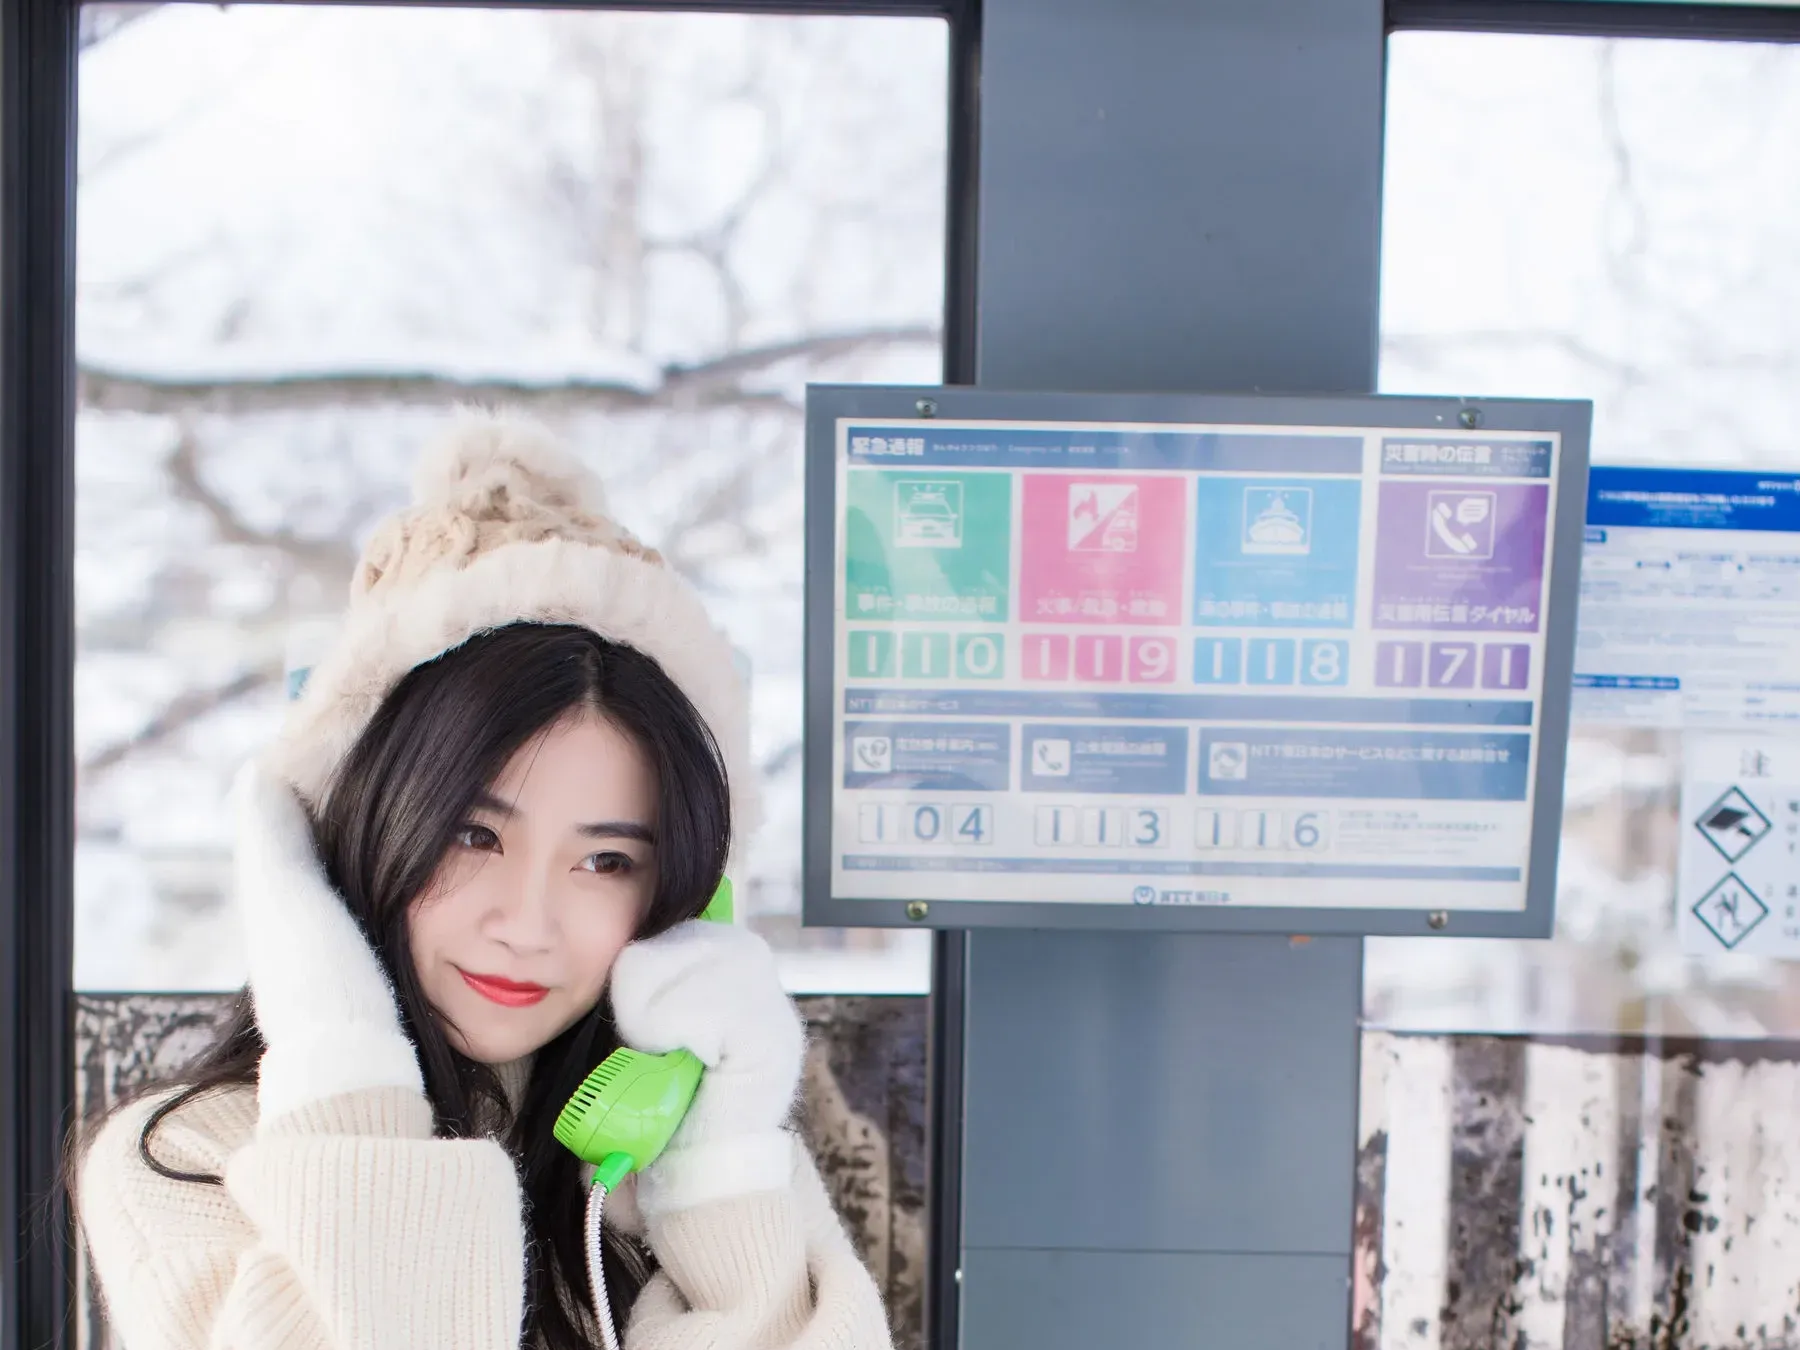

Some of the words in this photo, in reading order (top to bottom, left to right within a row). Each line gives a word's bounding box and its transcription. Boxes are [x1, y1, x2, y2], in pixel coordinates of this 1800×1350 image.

[867, 634, 998, 675] 110
[1040, 637, 1170, 680] 119
[1212, 641, 1341, 682] 118
[1393, 645, 1511, 686] 171
[876, 805, 984, 842] 104
[1053, 808, 1160, 845] 113
[1212, 812, 1320, 848] 116
